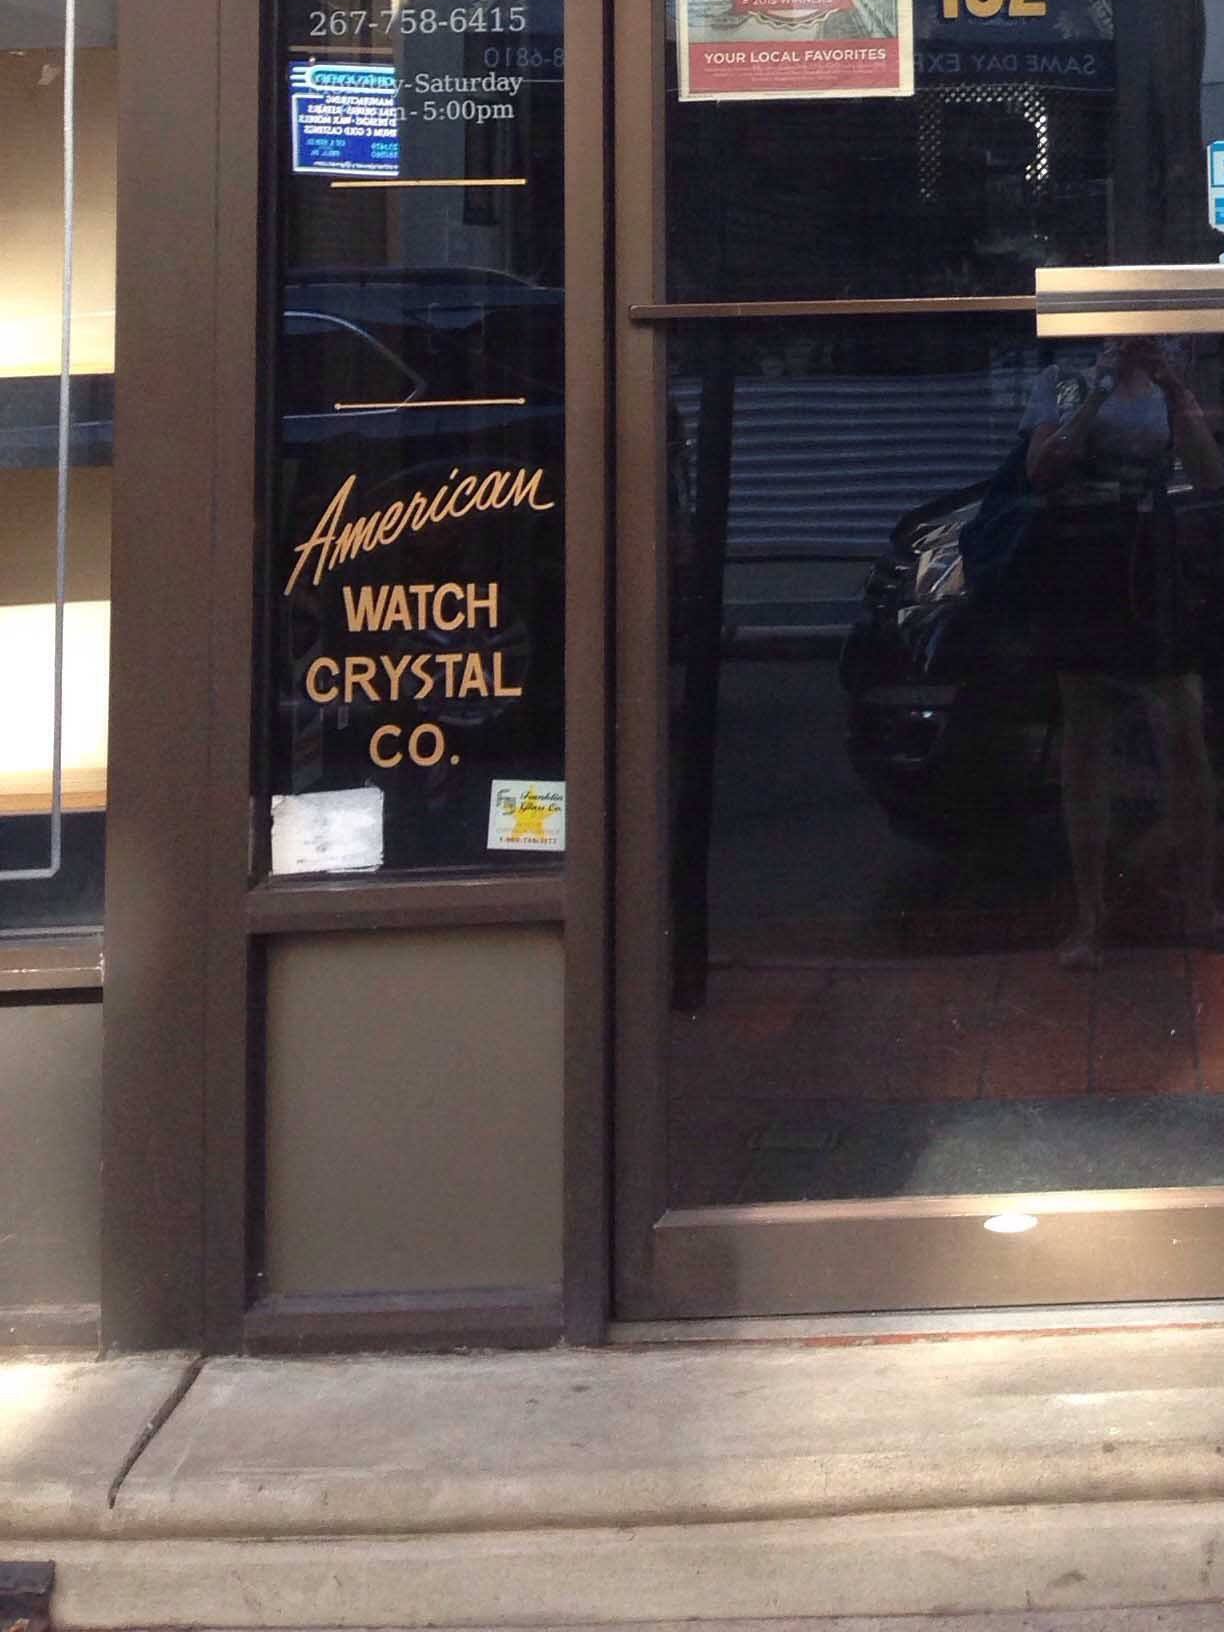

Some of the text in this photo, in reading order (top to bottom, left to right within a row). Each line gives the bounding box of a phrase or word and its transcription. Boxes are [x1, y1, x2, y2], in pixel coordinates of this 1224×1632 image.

[309, 7, 527, 36] 267-758-6415
[704, 48, 887, 65] YOUR LOCAL FAVORITES
[422, 101, 515, 124] 5:00pm
[284, 468, 555, 596] American
[342, 582, 499, 632] WATCH
[305, 652, 522, 704] CRYSTAL
[369, 723, 460, 768] CO.
